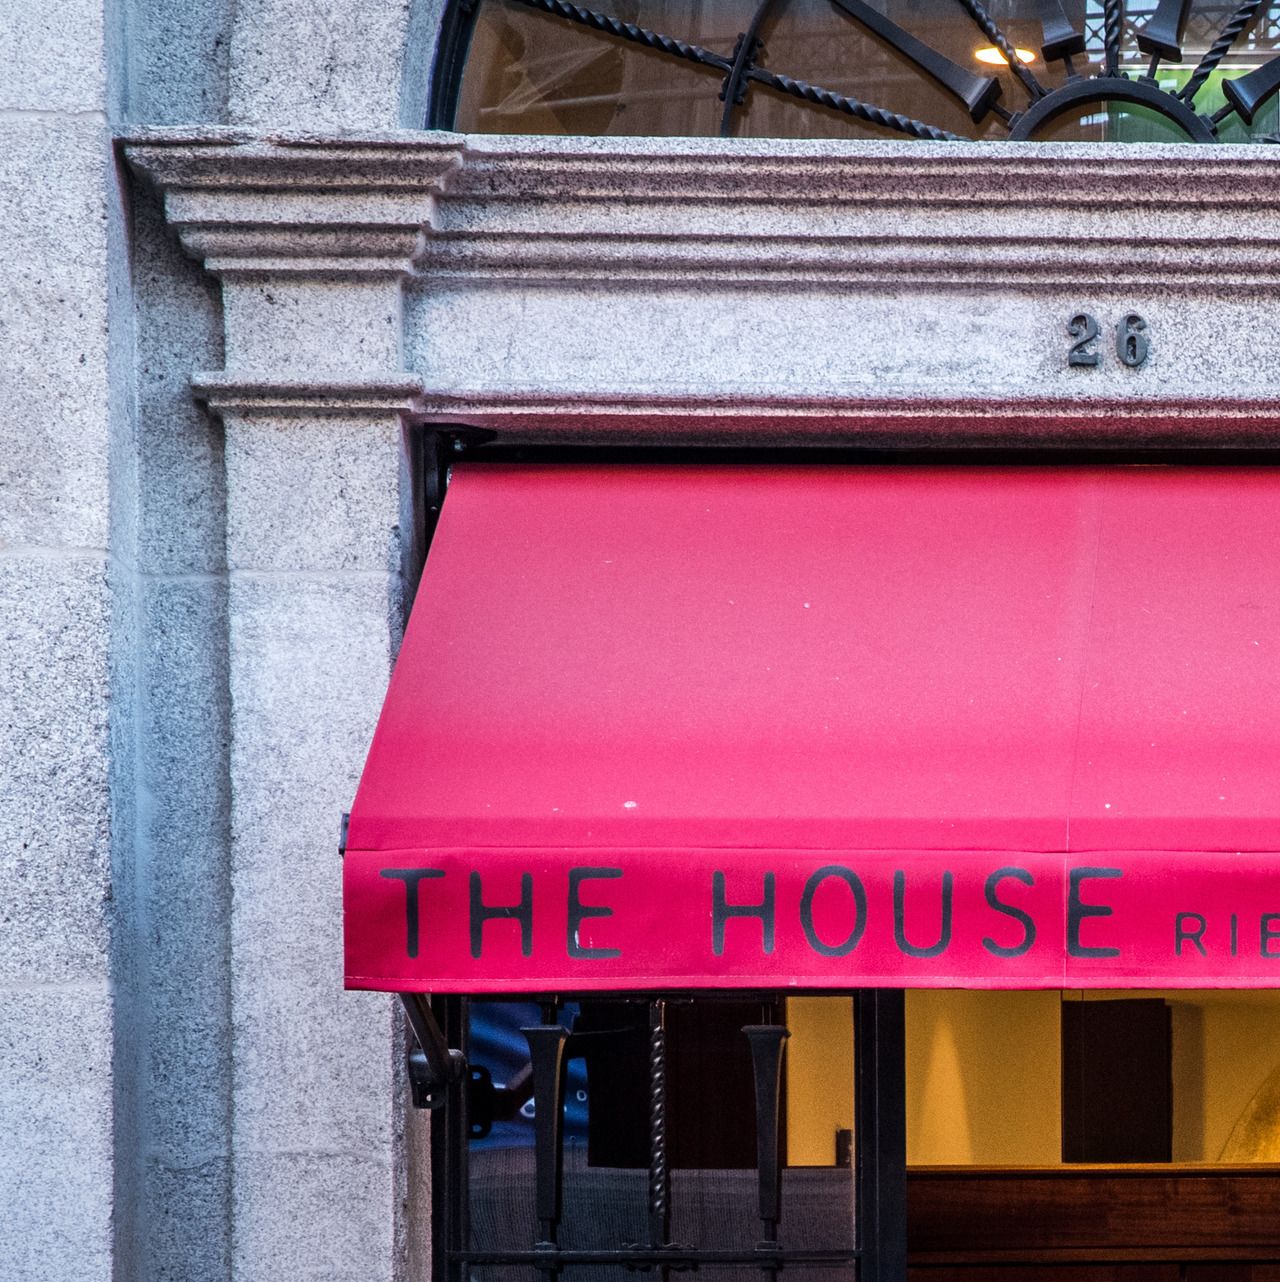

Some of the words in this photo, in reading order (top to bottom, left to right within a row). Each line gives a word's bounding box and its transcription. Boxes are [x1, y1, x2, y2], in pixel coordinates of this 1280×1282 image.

[1066, 312, 1150, 367] 26
[379, 866, 624, 960] THE
[711, 865, 1123, 960] HOUSE
